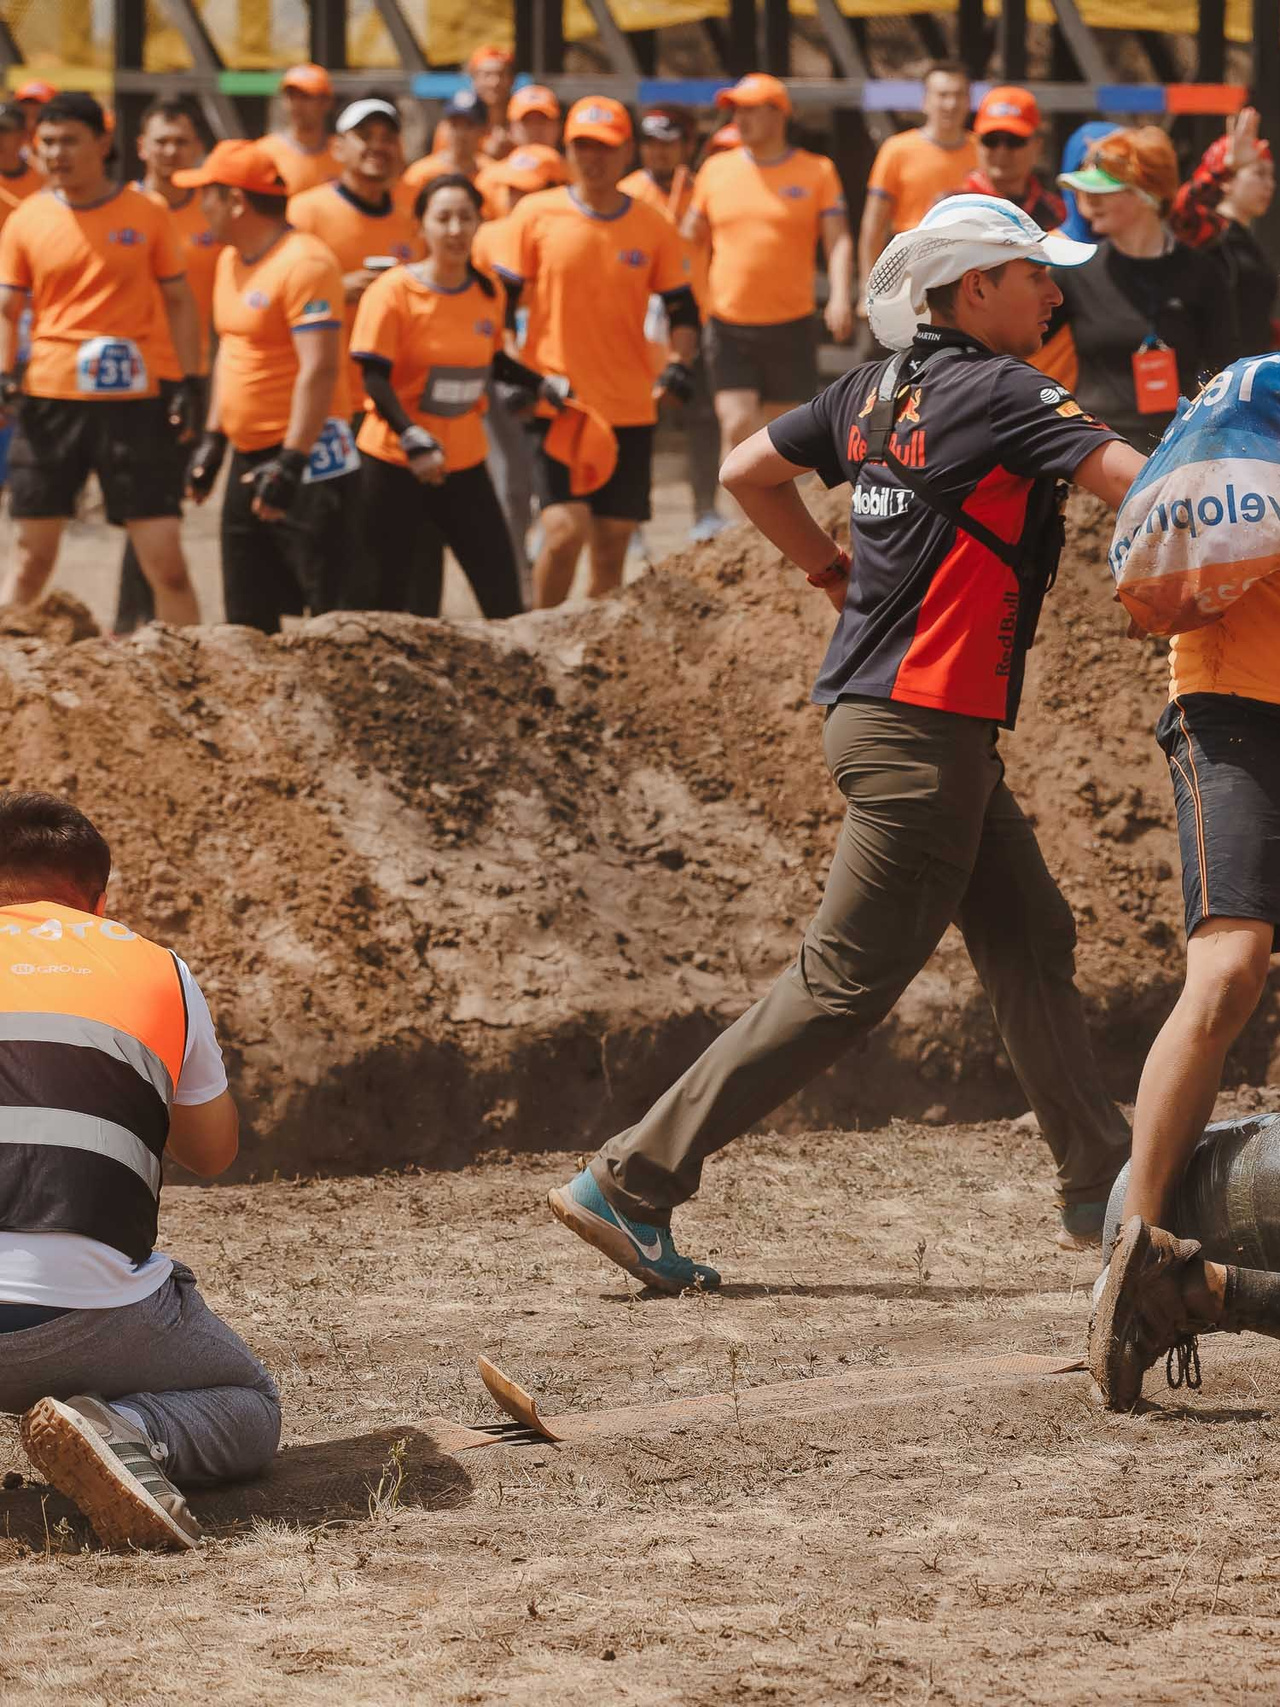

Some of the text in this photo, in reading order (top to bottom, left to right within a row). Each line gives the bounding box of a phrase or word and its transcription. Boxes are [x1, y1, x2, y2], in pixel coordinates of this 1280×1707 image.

[101, 358, 131, 385] 31
[311, 440, 343, 470] 31
[37, 964, 92, 975] GROUP
